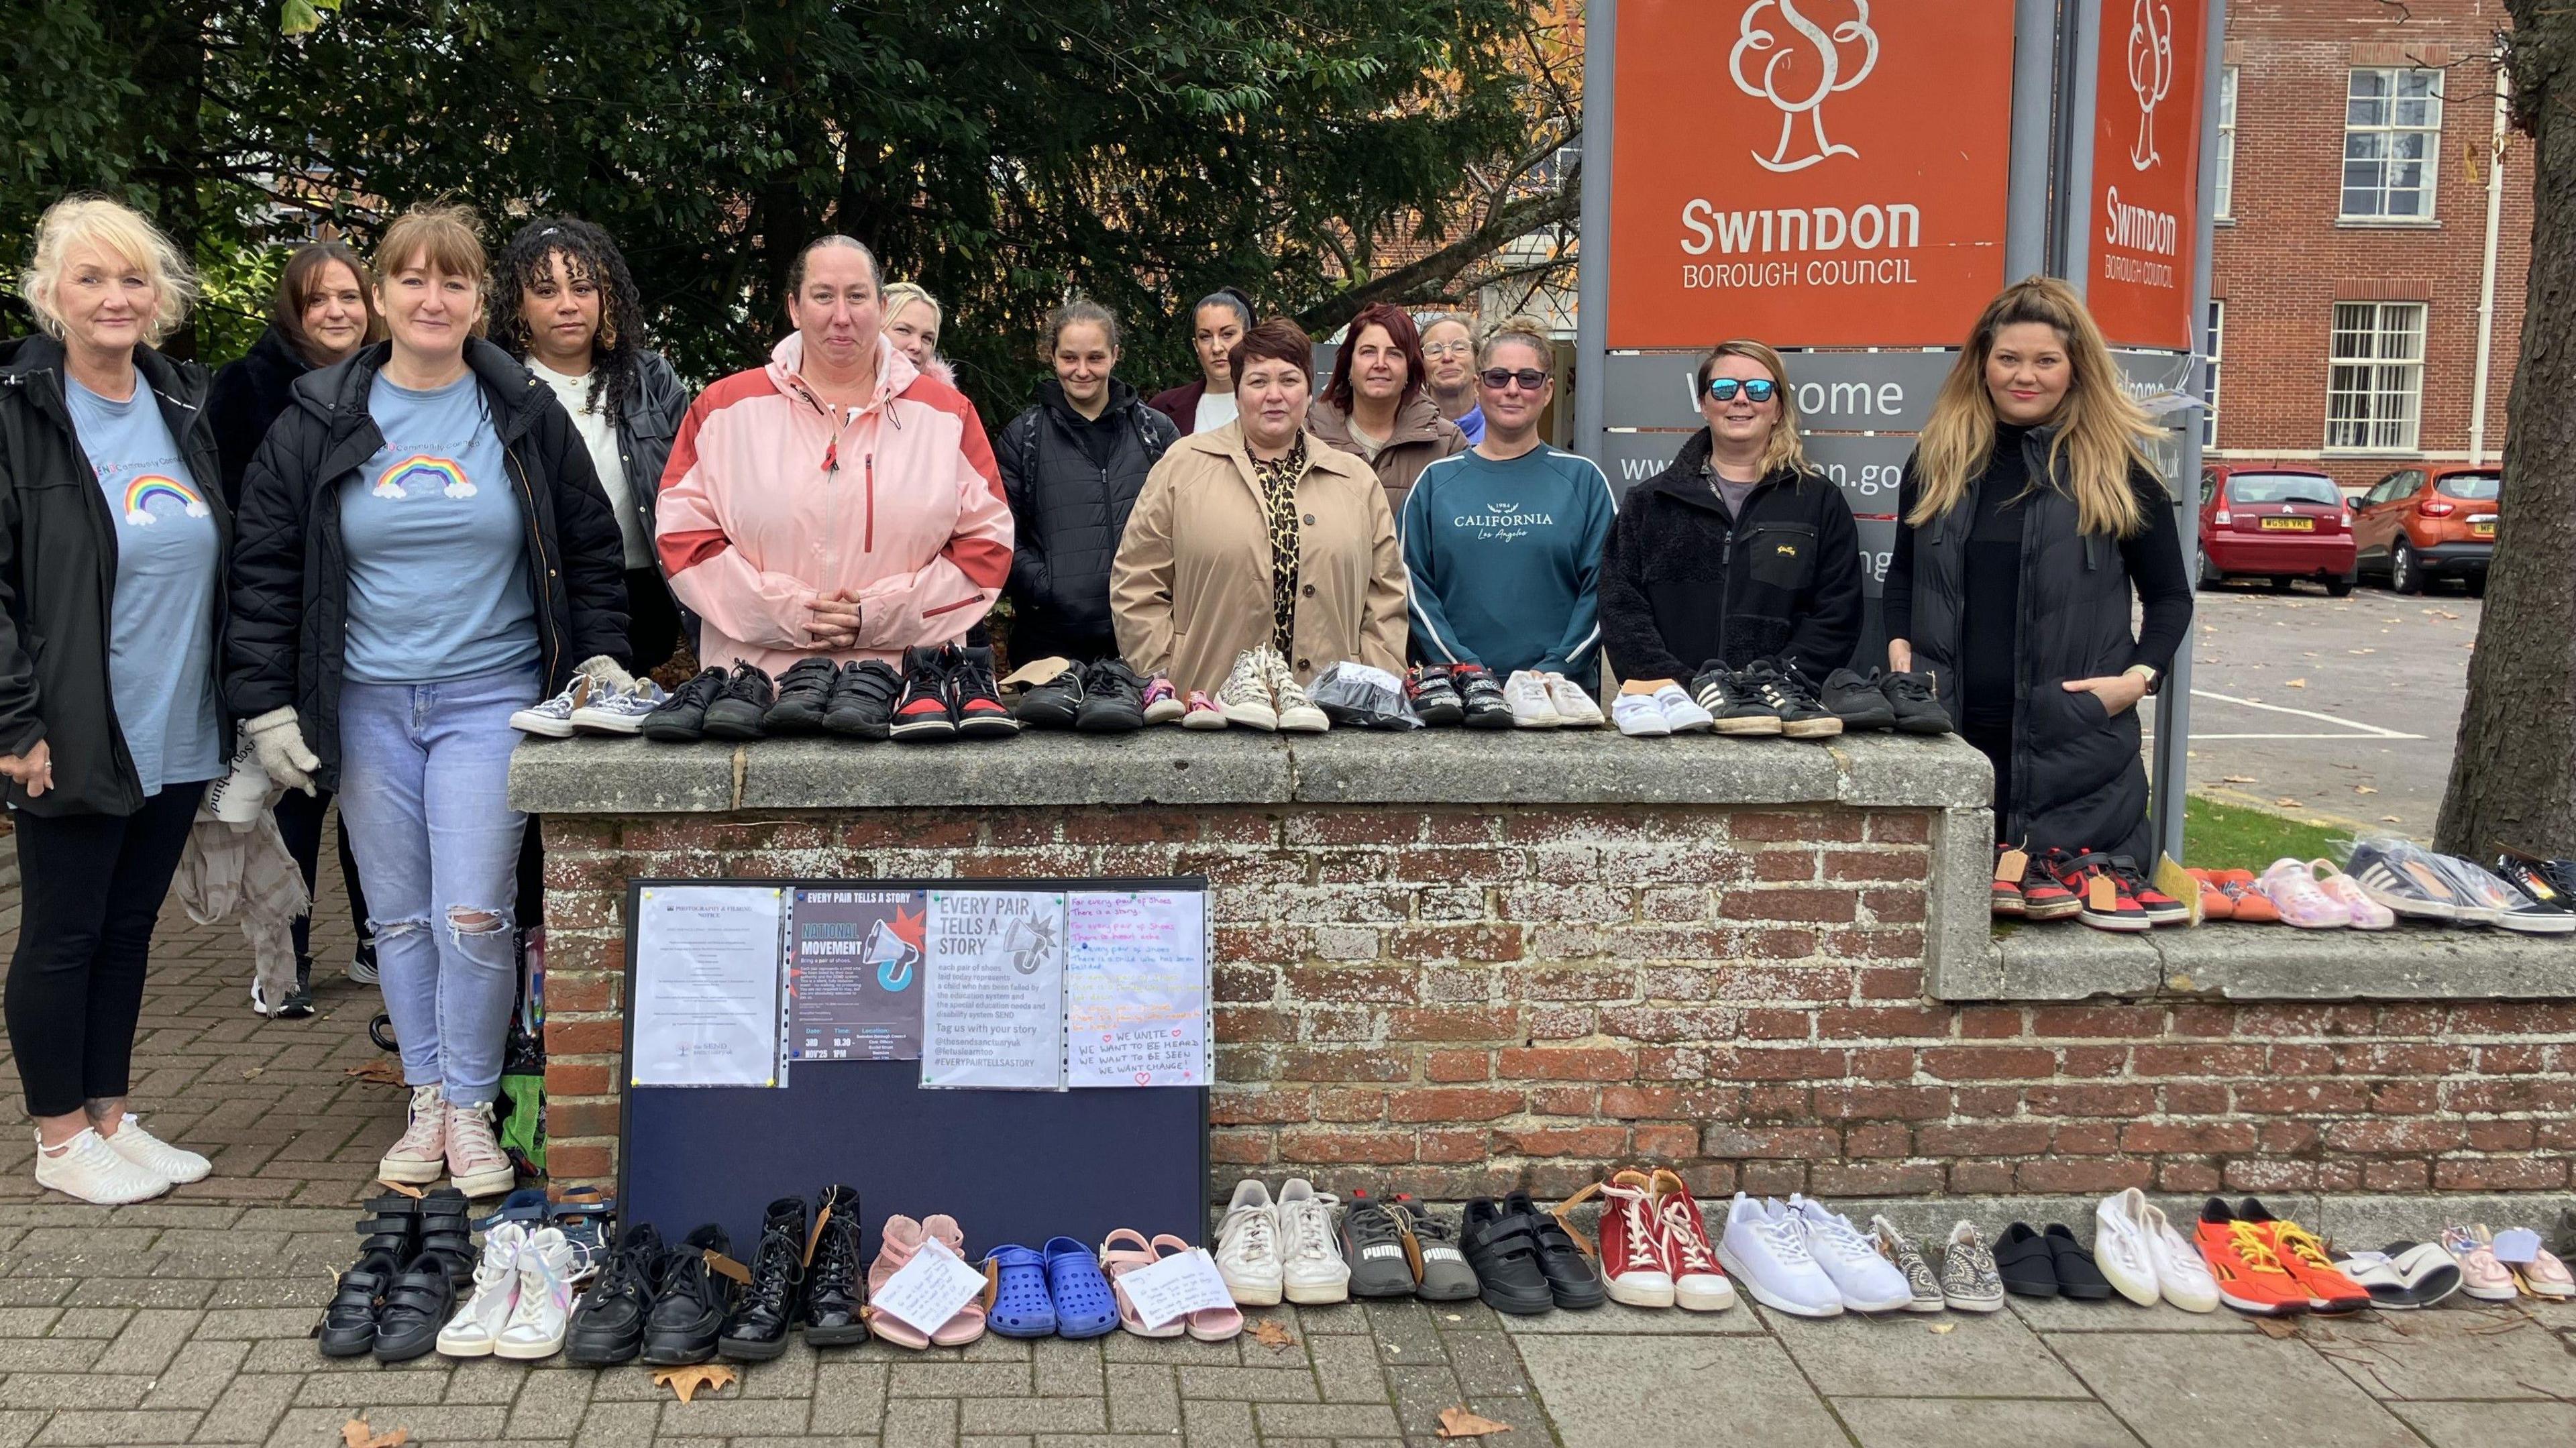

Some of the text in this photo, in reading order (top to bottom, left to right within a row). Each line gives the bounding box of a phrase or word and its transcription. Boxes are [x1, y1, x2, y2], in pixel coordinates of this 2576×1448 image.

[1682, 259, 1917, 288] BOROUGH COUNCIL
[2105, 254, 2174, 288] BOROUGH COUNCIL
[1454, 514, 1554, 527] CALIFORNIA
[1478, 528, 1528, 543] Los Angeles
[808, 893, 910, 903] EVERY PAIR TELLS A STORY
[1088, 899, 1112, 908] every
[1138, 898, 1146, 906] of
[941, 897, 1029, 915] EVERY PAIR
[802, 923, 859, 939] NATIONAL
[941, 917, 998, 935] TELLS A
[802, 941, 862, 955] MOVEMENT
[939, 938, 987, 956] STORY
[957, 964, 970, 972] pair
[953, 974, 971, 982] today
[950, 1002, 974, 1010] special
[936, 1023, 953, 1034] Tag
[968, 1025, 987, 1033] with
[990, 1026, 1011, 1036] your
[1013, 1025, 1037, 1036] story
[1116, 1029, 1168, 1041] WE UNITE
[806, 1038, 818, 1046] 3RD
[834, 1038, 851, 1046] 10.30
[1079, 1046, 1095, 1056] WE
[1099, 1044, 1127, 1053] WANT
[1147, 1042, 1161, 1050] BE
[1164, 1040, 1199, 1050] HEARD
[833, 1050, 847, 1058] 1PM
[1079, 1056, 1094, 1065] WE
[1099, 1055, 1128, 1064] WANT
[1148, 1053, 1161, 1061] BE
[935, 1058, 1034, 1068] #EVERYPAIRTELLSASTORY
[1099, 1066, 1114, 1075] WE
[1117, 1064, 1144, 1073] WANT
[1362, 1245, 1402, 1260] PUMA
[1422, 1247, 1462, 1264] PUMA
